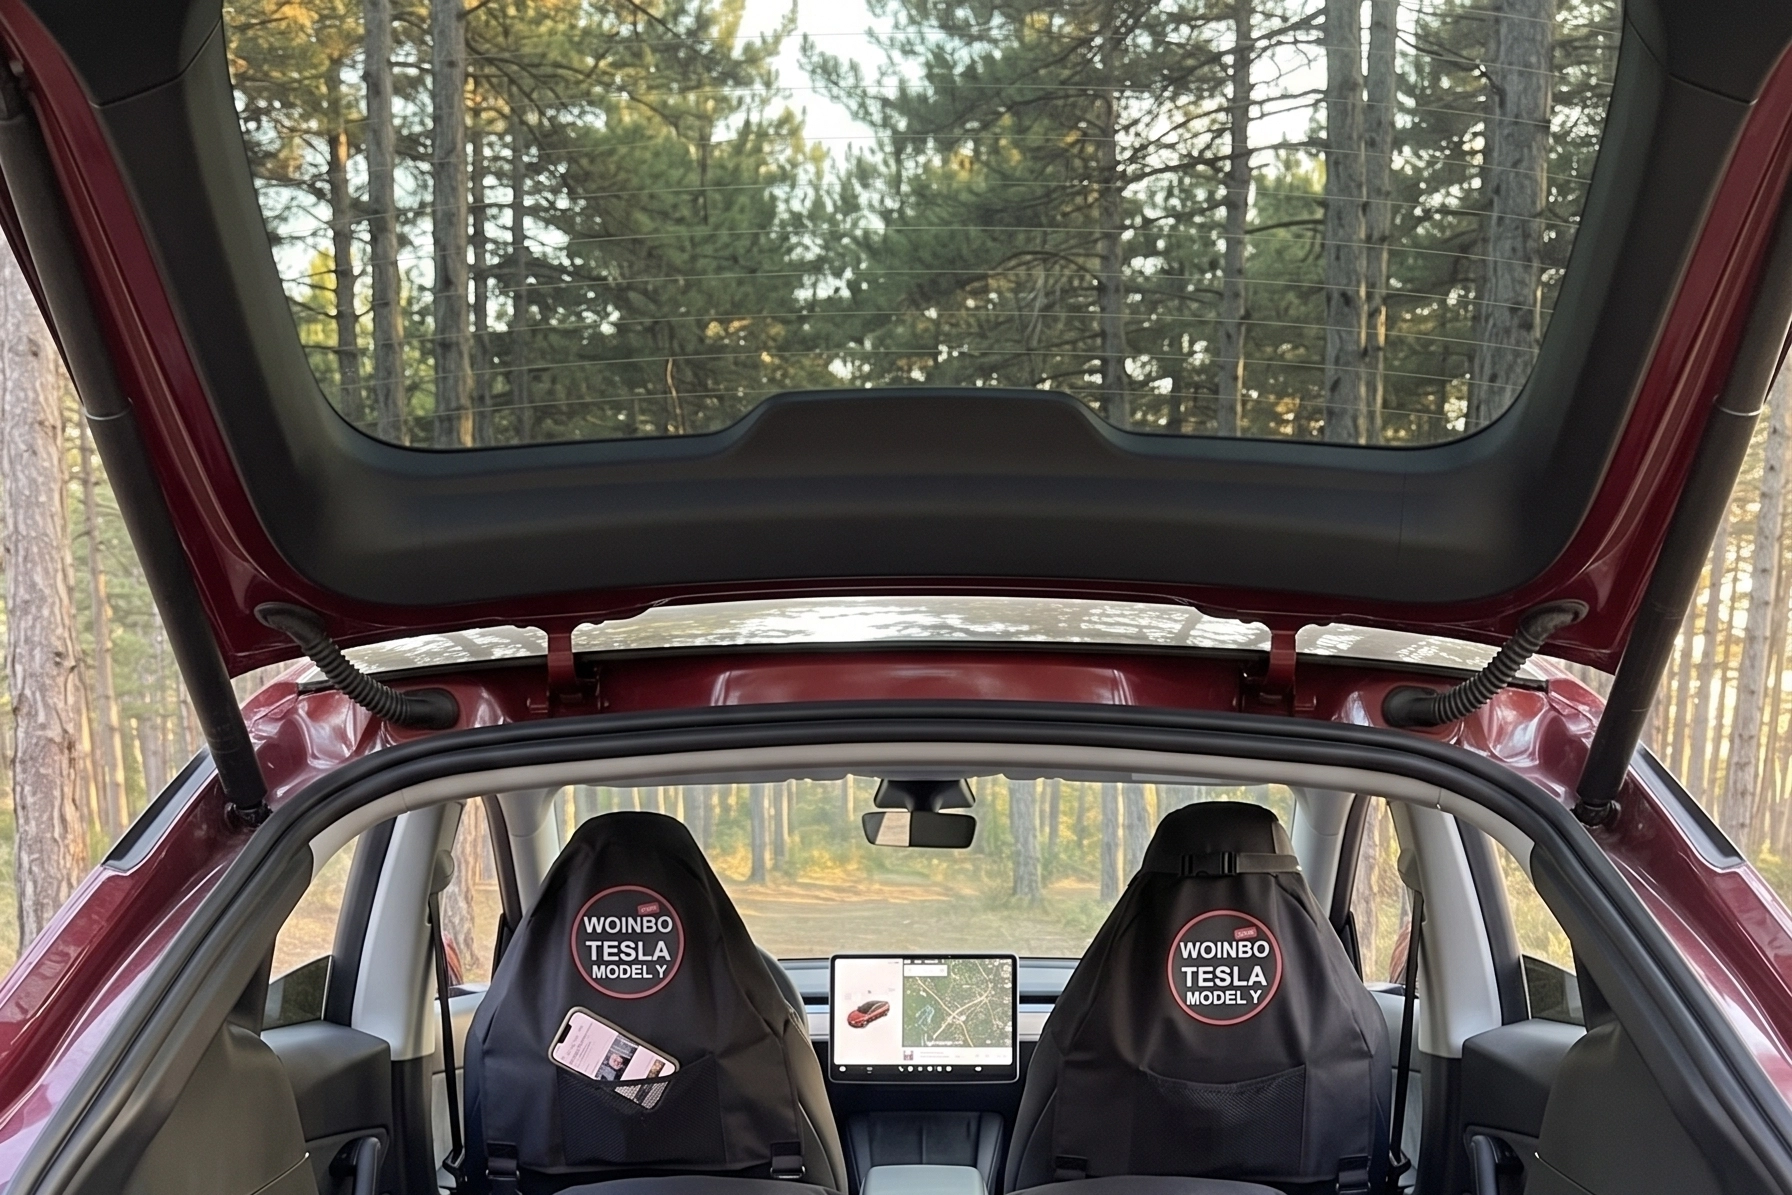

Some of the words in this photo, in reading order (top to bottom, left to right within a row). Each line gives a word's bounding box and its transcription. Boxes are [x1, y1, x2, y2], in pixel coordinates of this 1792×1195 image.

[583, 916, 673, 933] WOINBO
[585, 941, 671, 961] TESLA
[1180, 941, 1270, 959] WOINBO
[592, 965, 653, 979] MODEL
[655, 965, 667, 979] Y
[1181, 965, 1268, 987] TESLA
[1186, 991, 1247, 1005] MODEL
[1249, 990, 1262, 1004] Y
